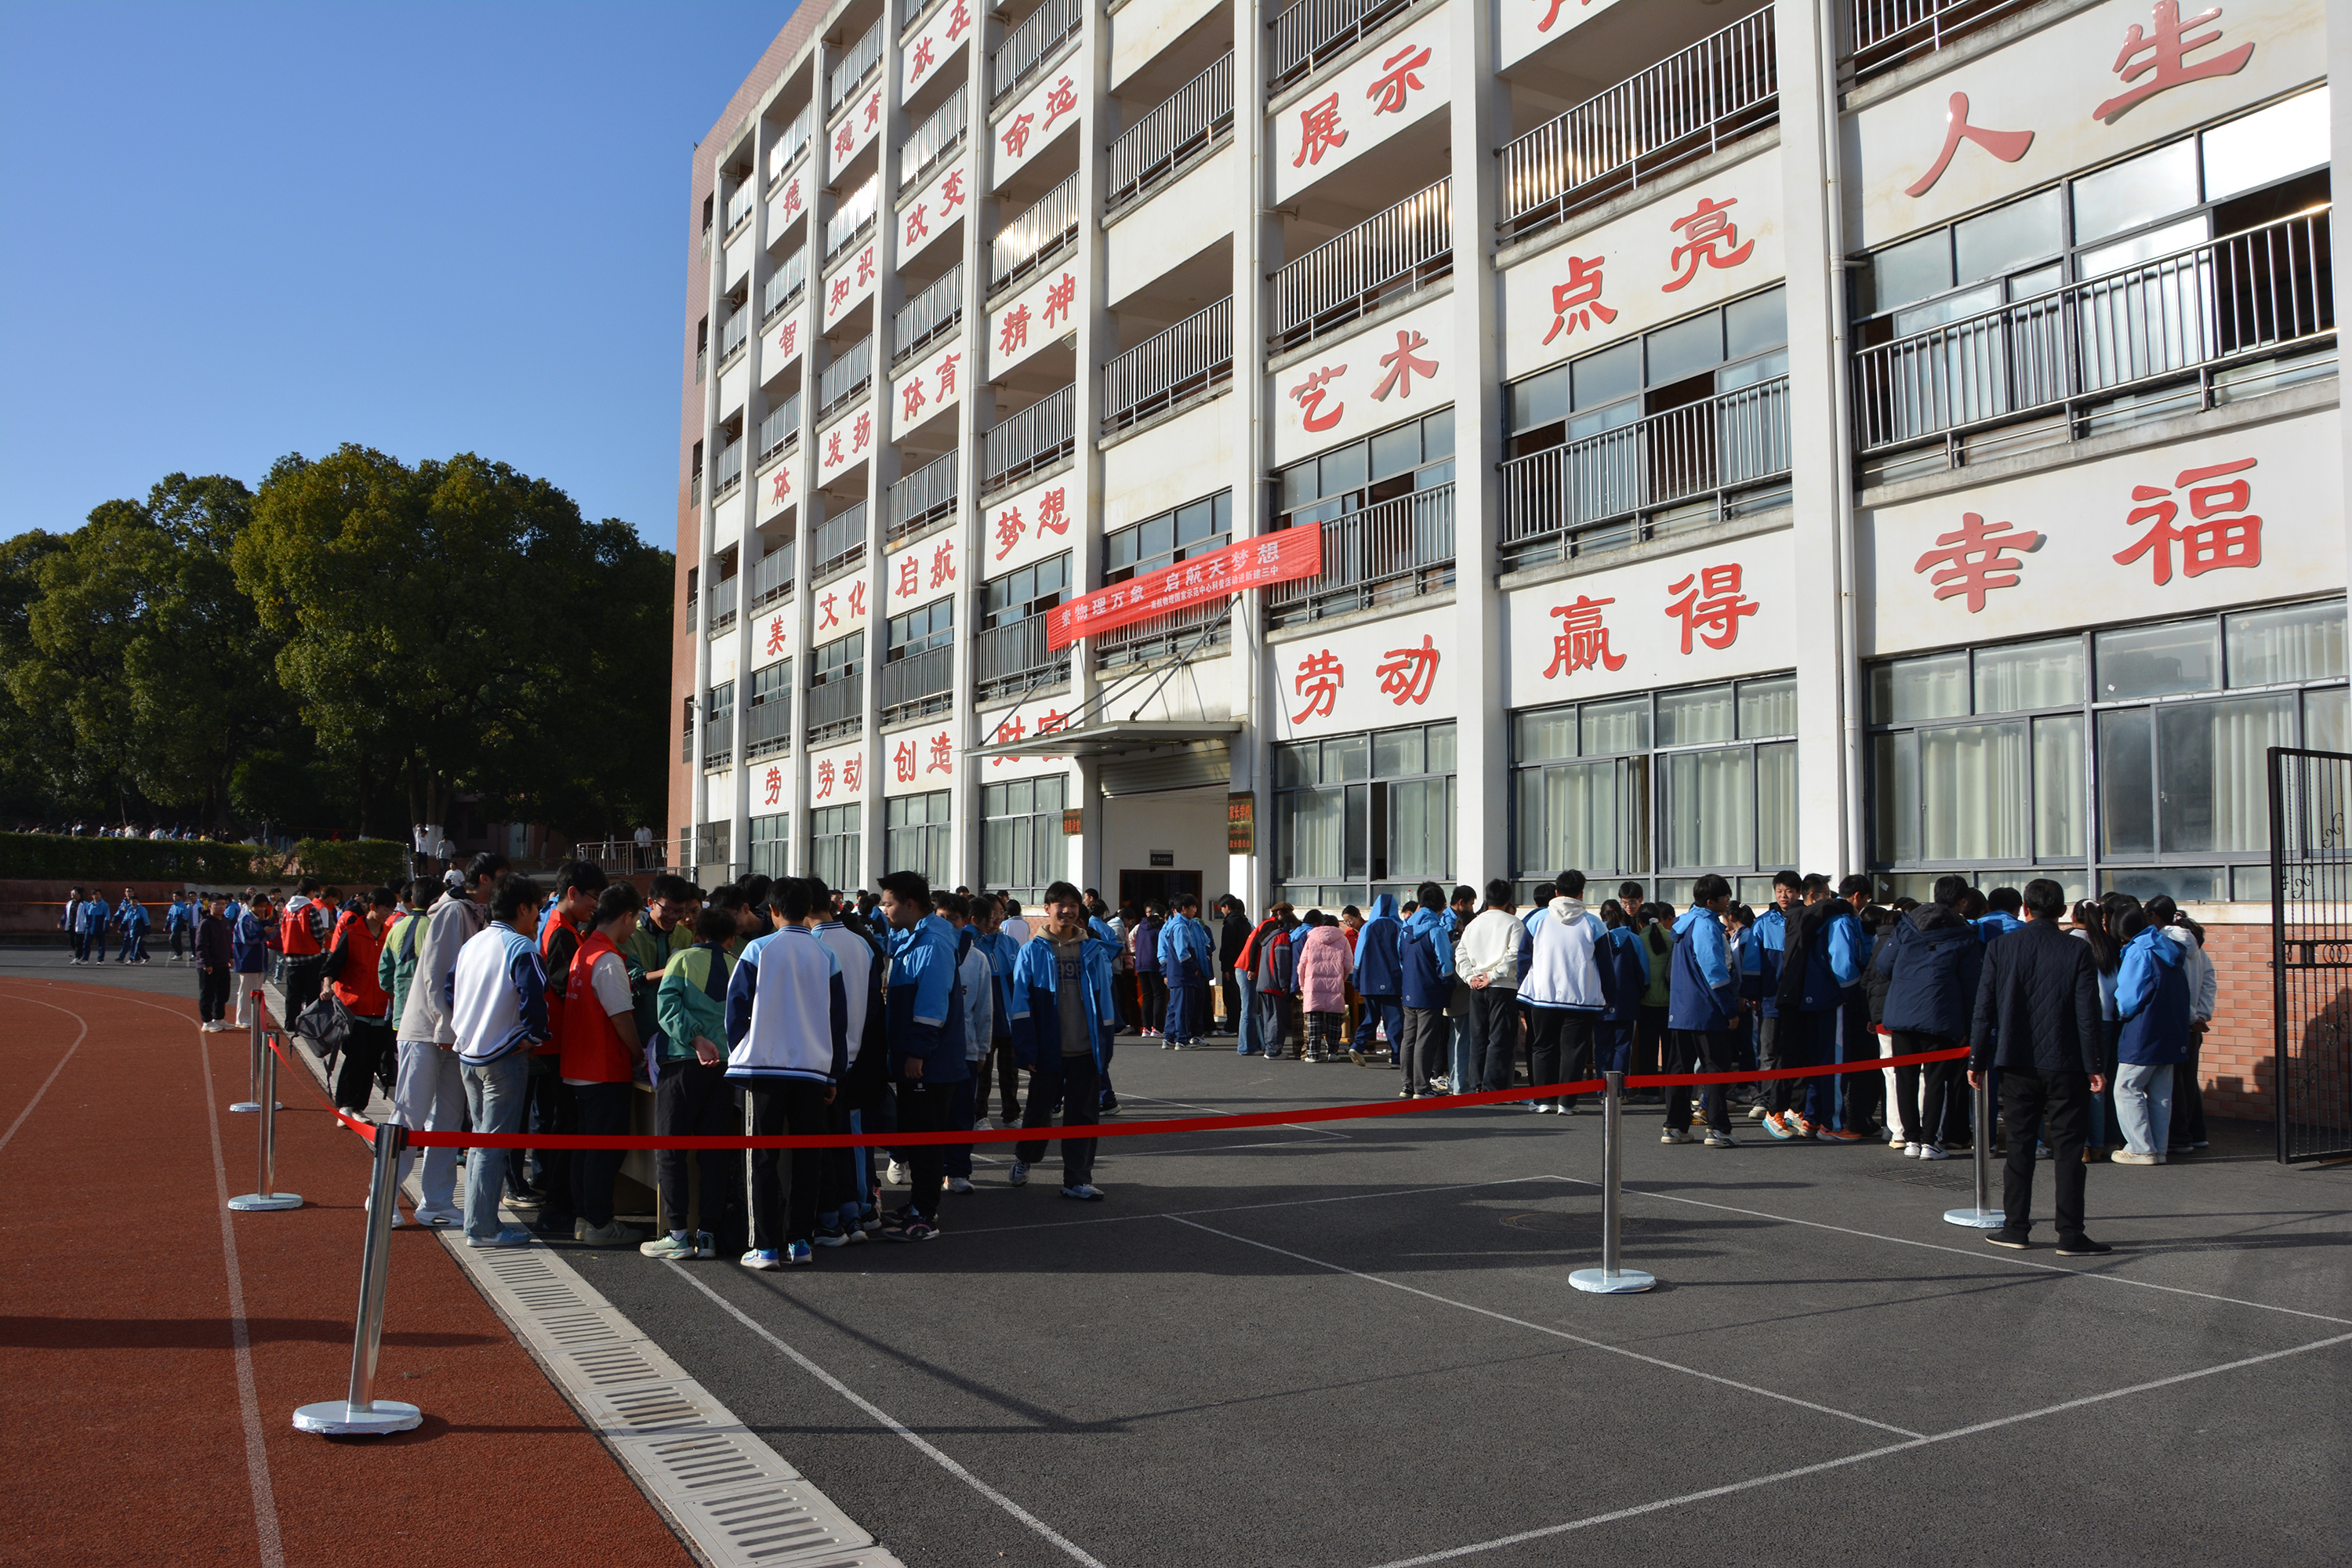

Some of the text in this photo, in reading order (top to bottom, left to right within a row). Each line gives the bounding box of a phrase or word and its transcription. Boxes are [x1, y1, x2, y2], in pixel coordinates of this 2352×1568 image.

[779, 75, 1077, 358] 智 知识 改变 命运
[834, 86, 881, 163] 德育
[910, 0, 971, 84] 放在
[766, 0, 2254, 655] 美 文化 启航 梦想 艺术 点亮 人生
[771, 44, 1431, 506] 体 发扬 体育 精神 展示
[764, 766, 782, 805] 劳
[816, 752, 862, 800] 劳动
[893, 731, 953, 782] 创造
[1292, 633, 1439, 724] 劳动
[1542, 562, 1759, 681] 赢得
[1915, 457, 2263, 614] 幸福
[1163, 541, 1280, 593] 启航天梦想
